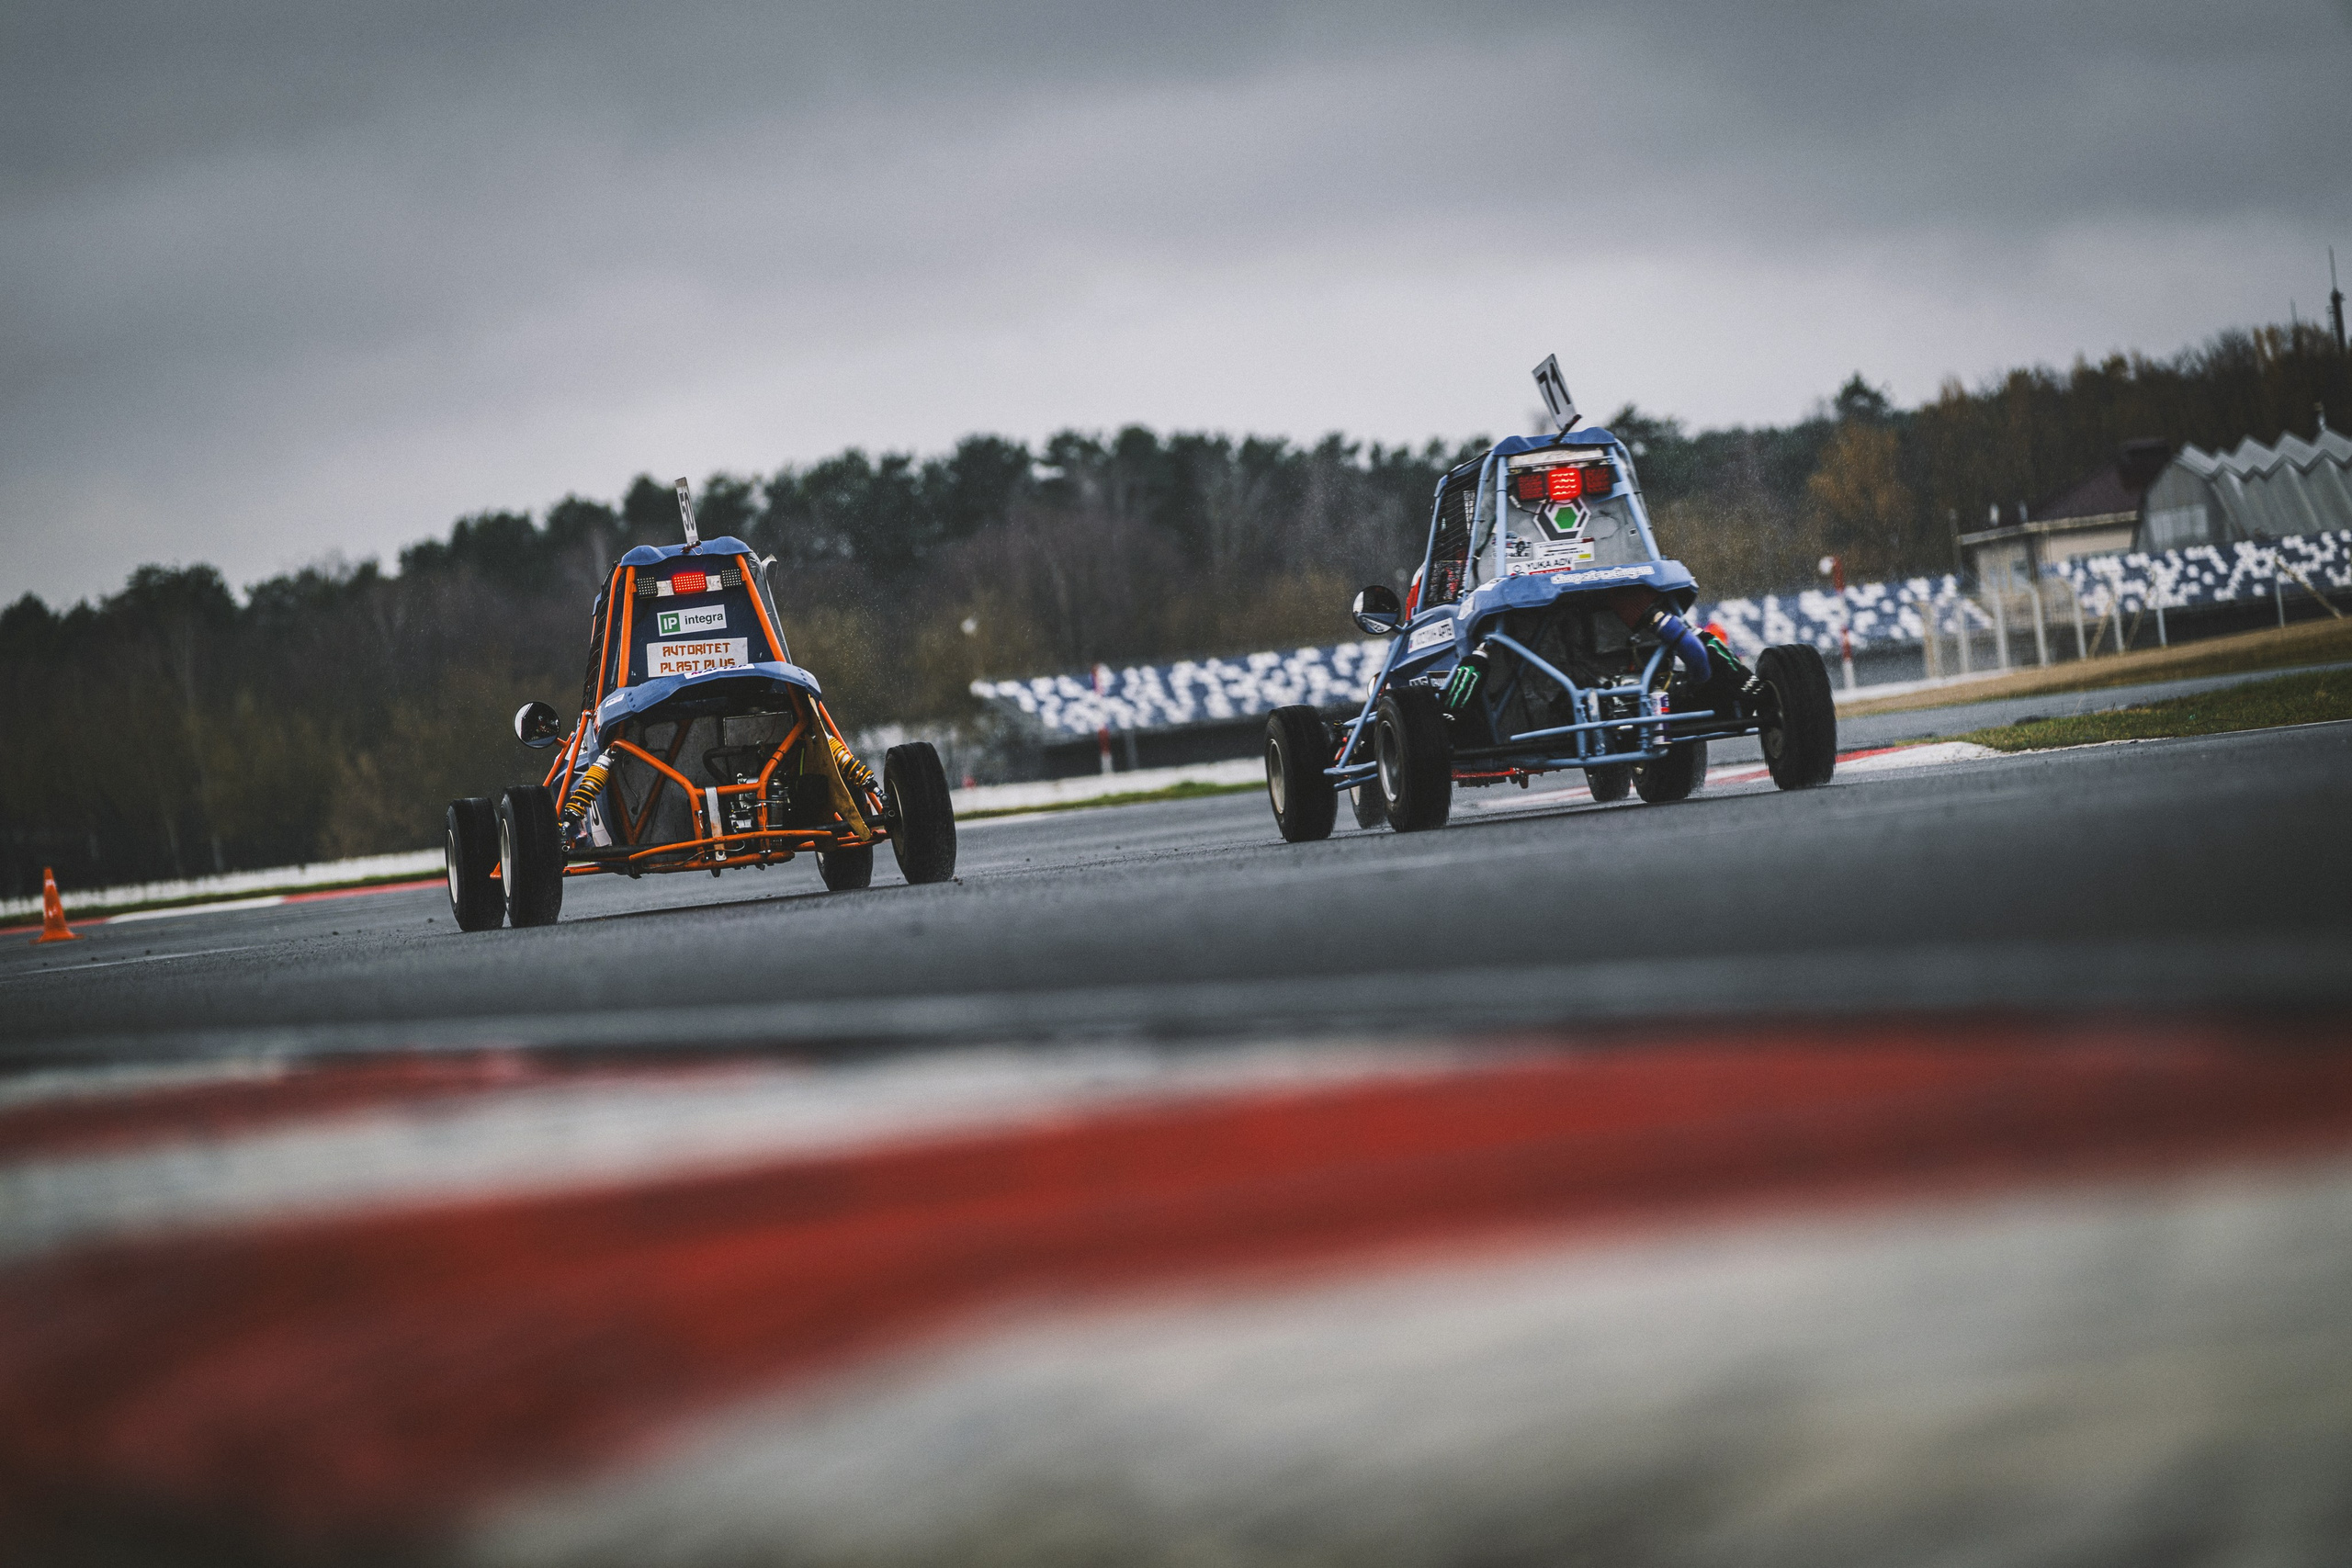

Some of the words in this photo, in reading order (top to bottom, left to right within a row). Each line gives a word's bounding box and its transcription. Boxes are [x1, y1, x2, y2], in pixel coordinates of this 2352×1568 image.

[1536, 362, 1571, 415] 71
[679, 491, 695, 531] 50
[1526, 561, 1552, 570] YUKA
[662, 617, 678, 630] IP
[684, 613, 724, 626] integra
[662, 642, 730, 657] AUTORITET
[660, 660, 700, 674] PLAST
